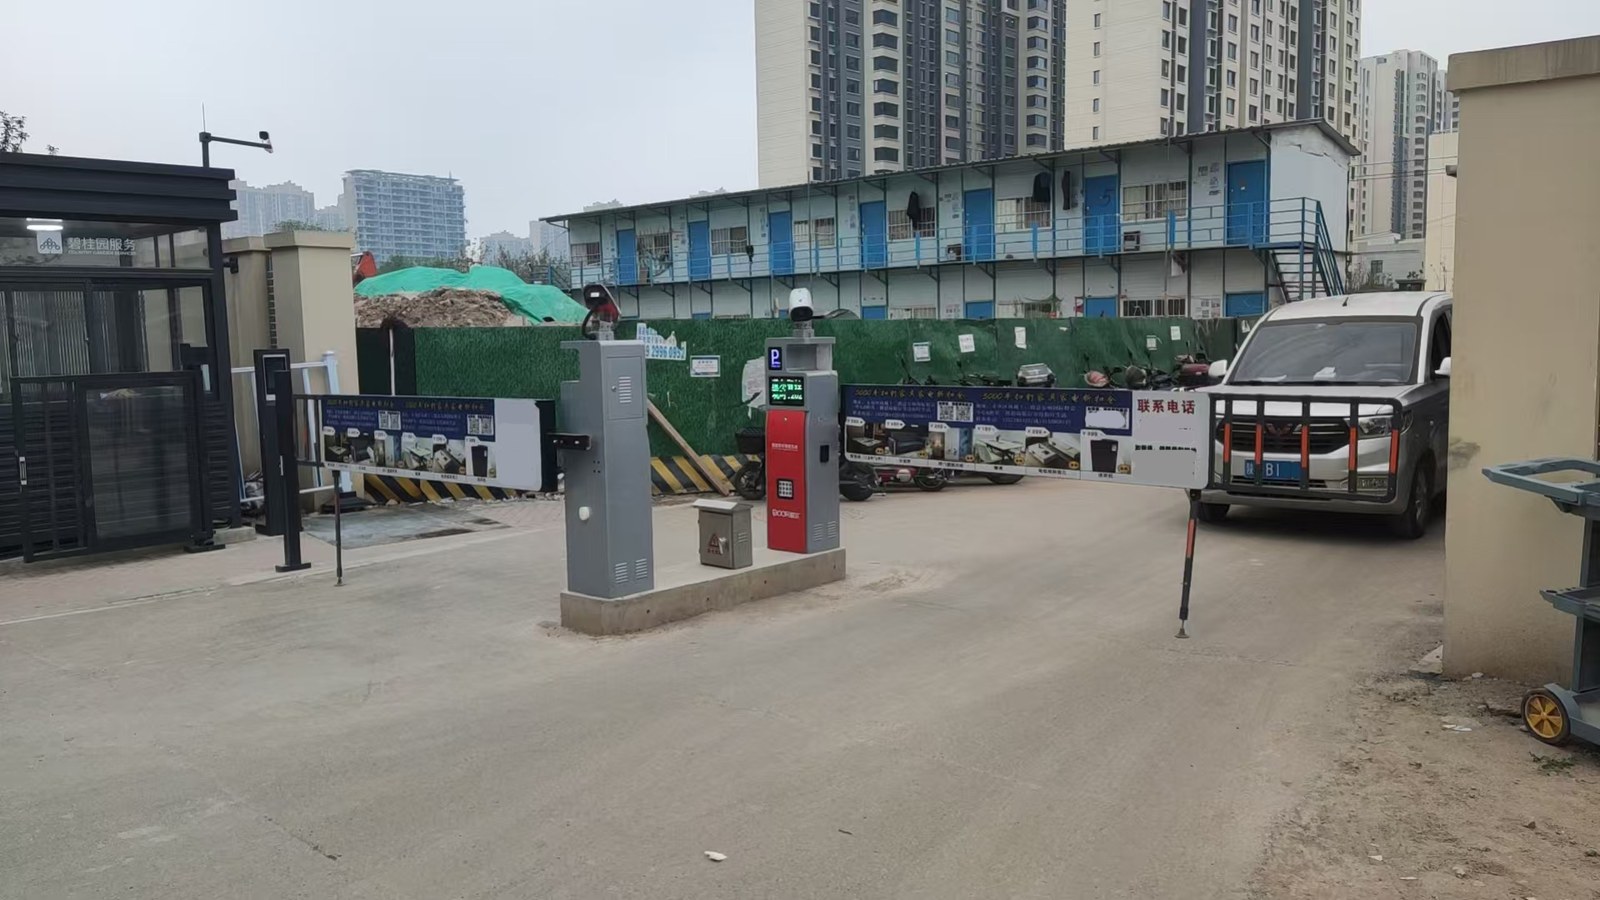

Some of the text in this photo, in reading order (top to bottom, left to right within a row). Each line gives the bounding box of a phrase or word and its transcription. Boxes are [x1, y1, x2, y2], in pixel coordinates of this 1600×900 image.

[67, 237, 136, 251] 碧桂园服务
[1137, 398, 1196, 415] 联系电话
